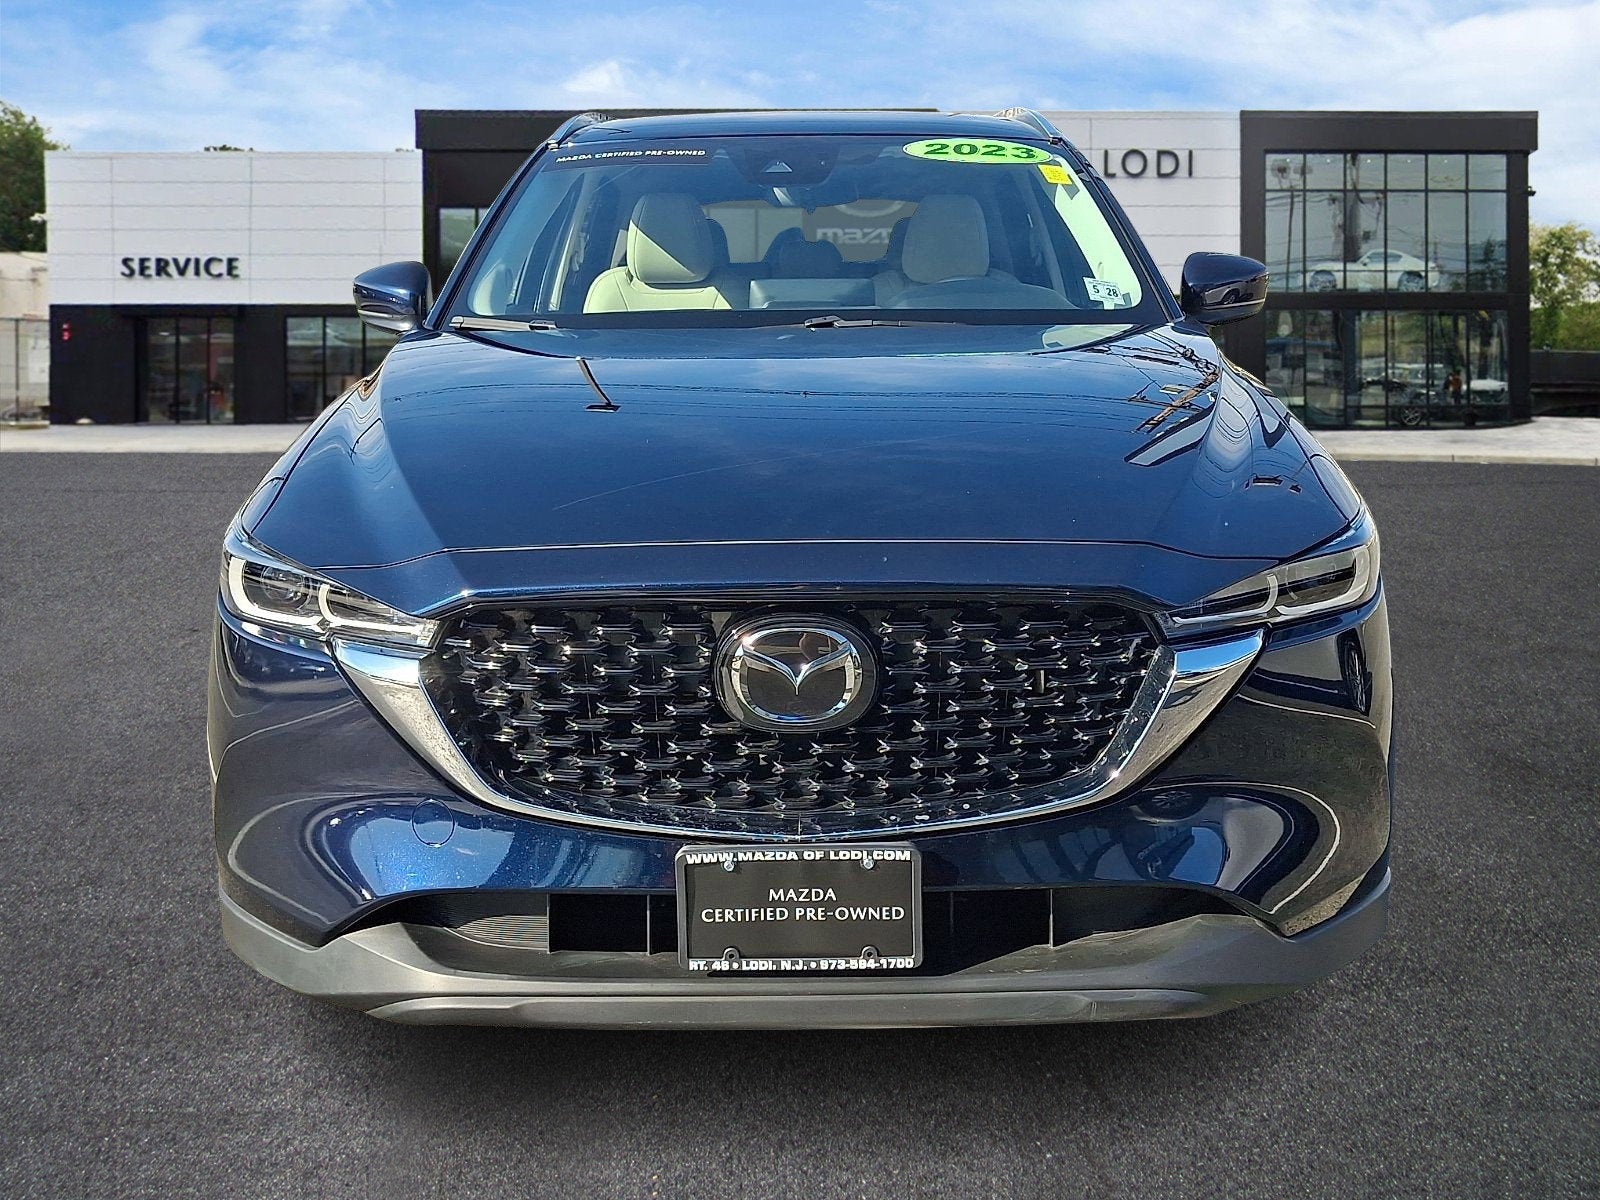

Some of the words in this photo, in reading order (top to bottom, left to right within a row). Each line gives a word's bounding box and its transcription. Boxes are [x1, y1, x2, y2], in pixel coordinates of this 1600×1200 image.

[556, 154, 591, 163] MAZDA
[595, 150, 643, 159] CERTIFIED
[924, 143, 1037, 159] 2023
[1104, 149, 1193, 178] LODI
[120, 256, 240, 278] SERVICE
[1106, 288, 1119, 297] 28
[686, 851, 799, 864] WWW.MAZDA
[803, 850, 825, 860] OF
[829, 850, 911, 861] LODI.COM
[768, 888, 837, 902] MAZDA
[701, 908, 789, 923] CERTIFIED
[795, 907, 905, 921] PRE-OWNED
